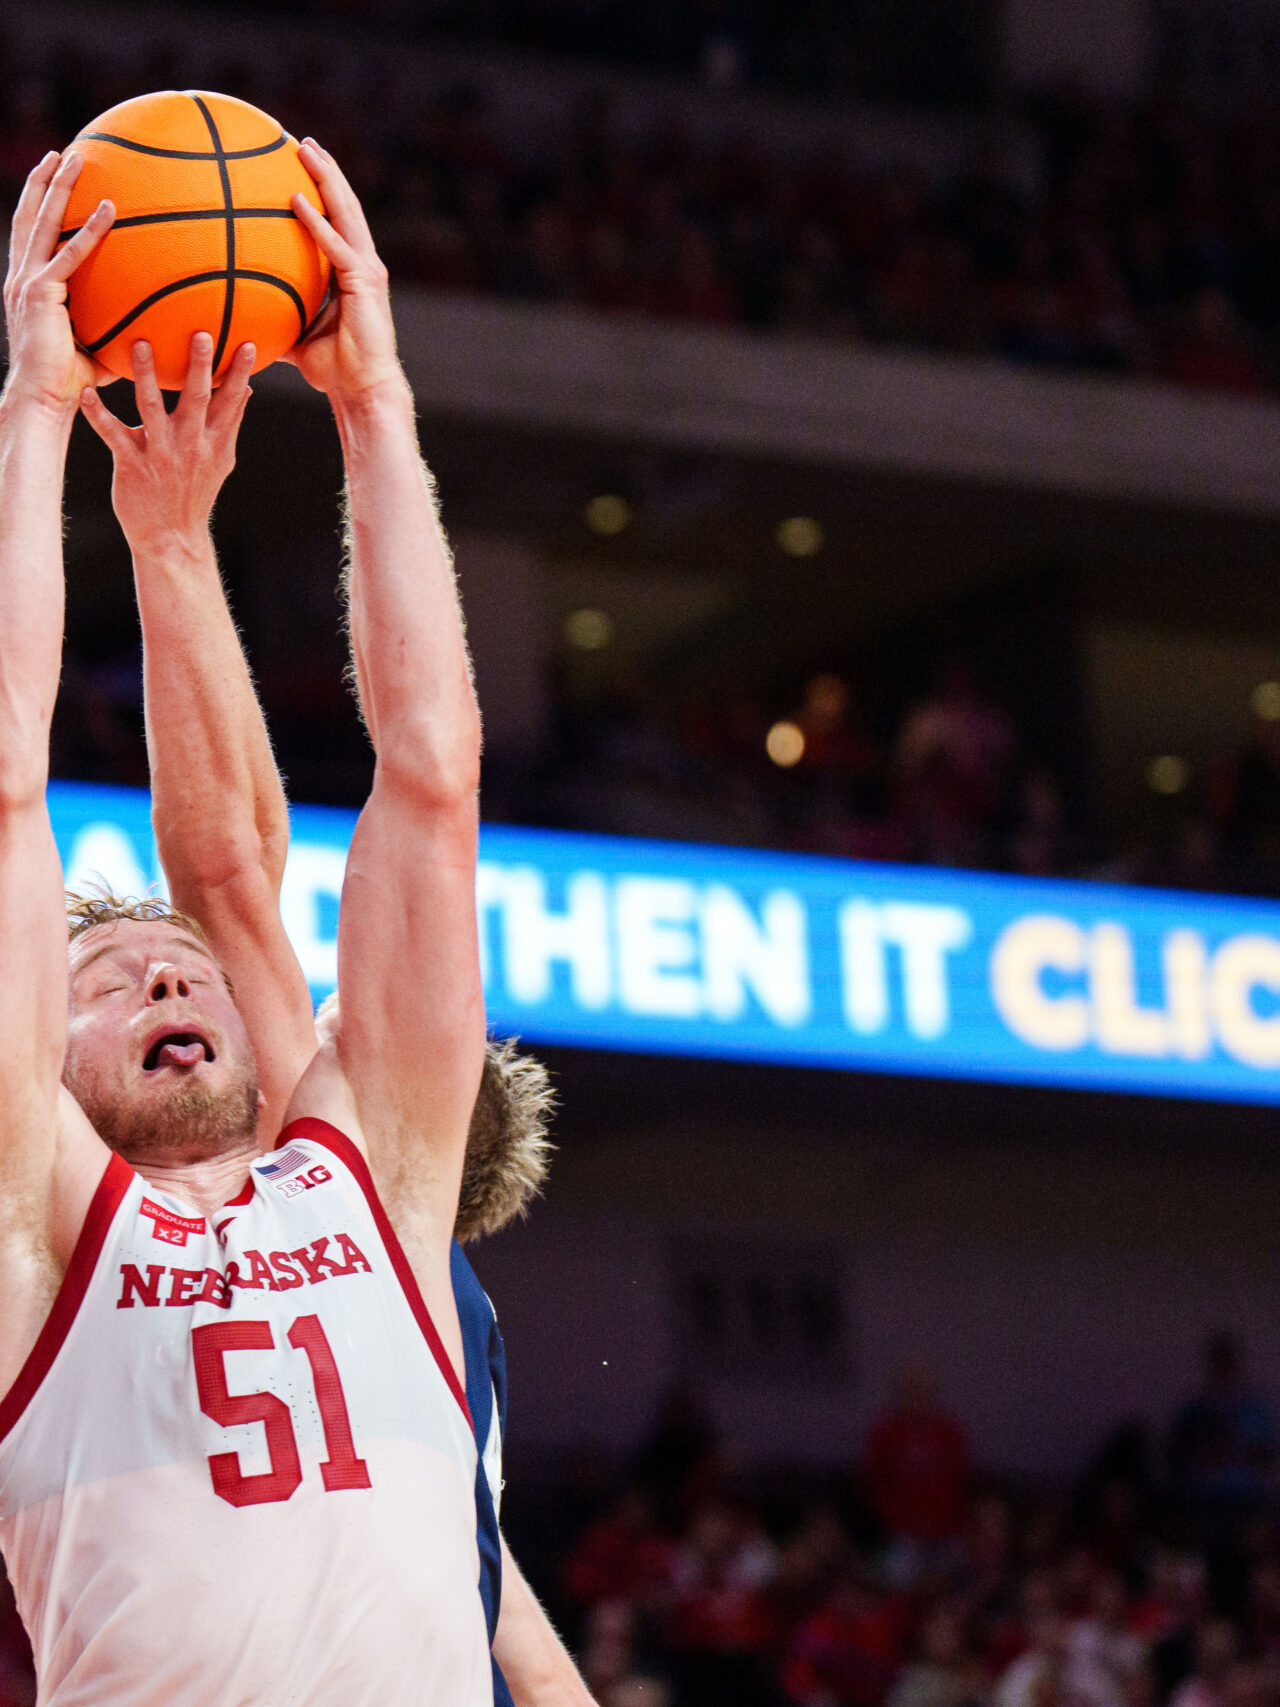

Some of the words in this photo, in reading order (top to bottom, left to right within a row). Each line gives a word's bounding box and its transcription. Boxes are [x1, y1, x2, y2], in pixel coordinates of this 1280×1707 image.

[838, 897, 972, 1041] IT
[143, 1203, 203, 1230] GRADUATE
[191, 1314, 371, 1508] 51
